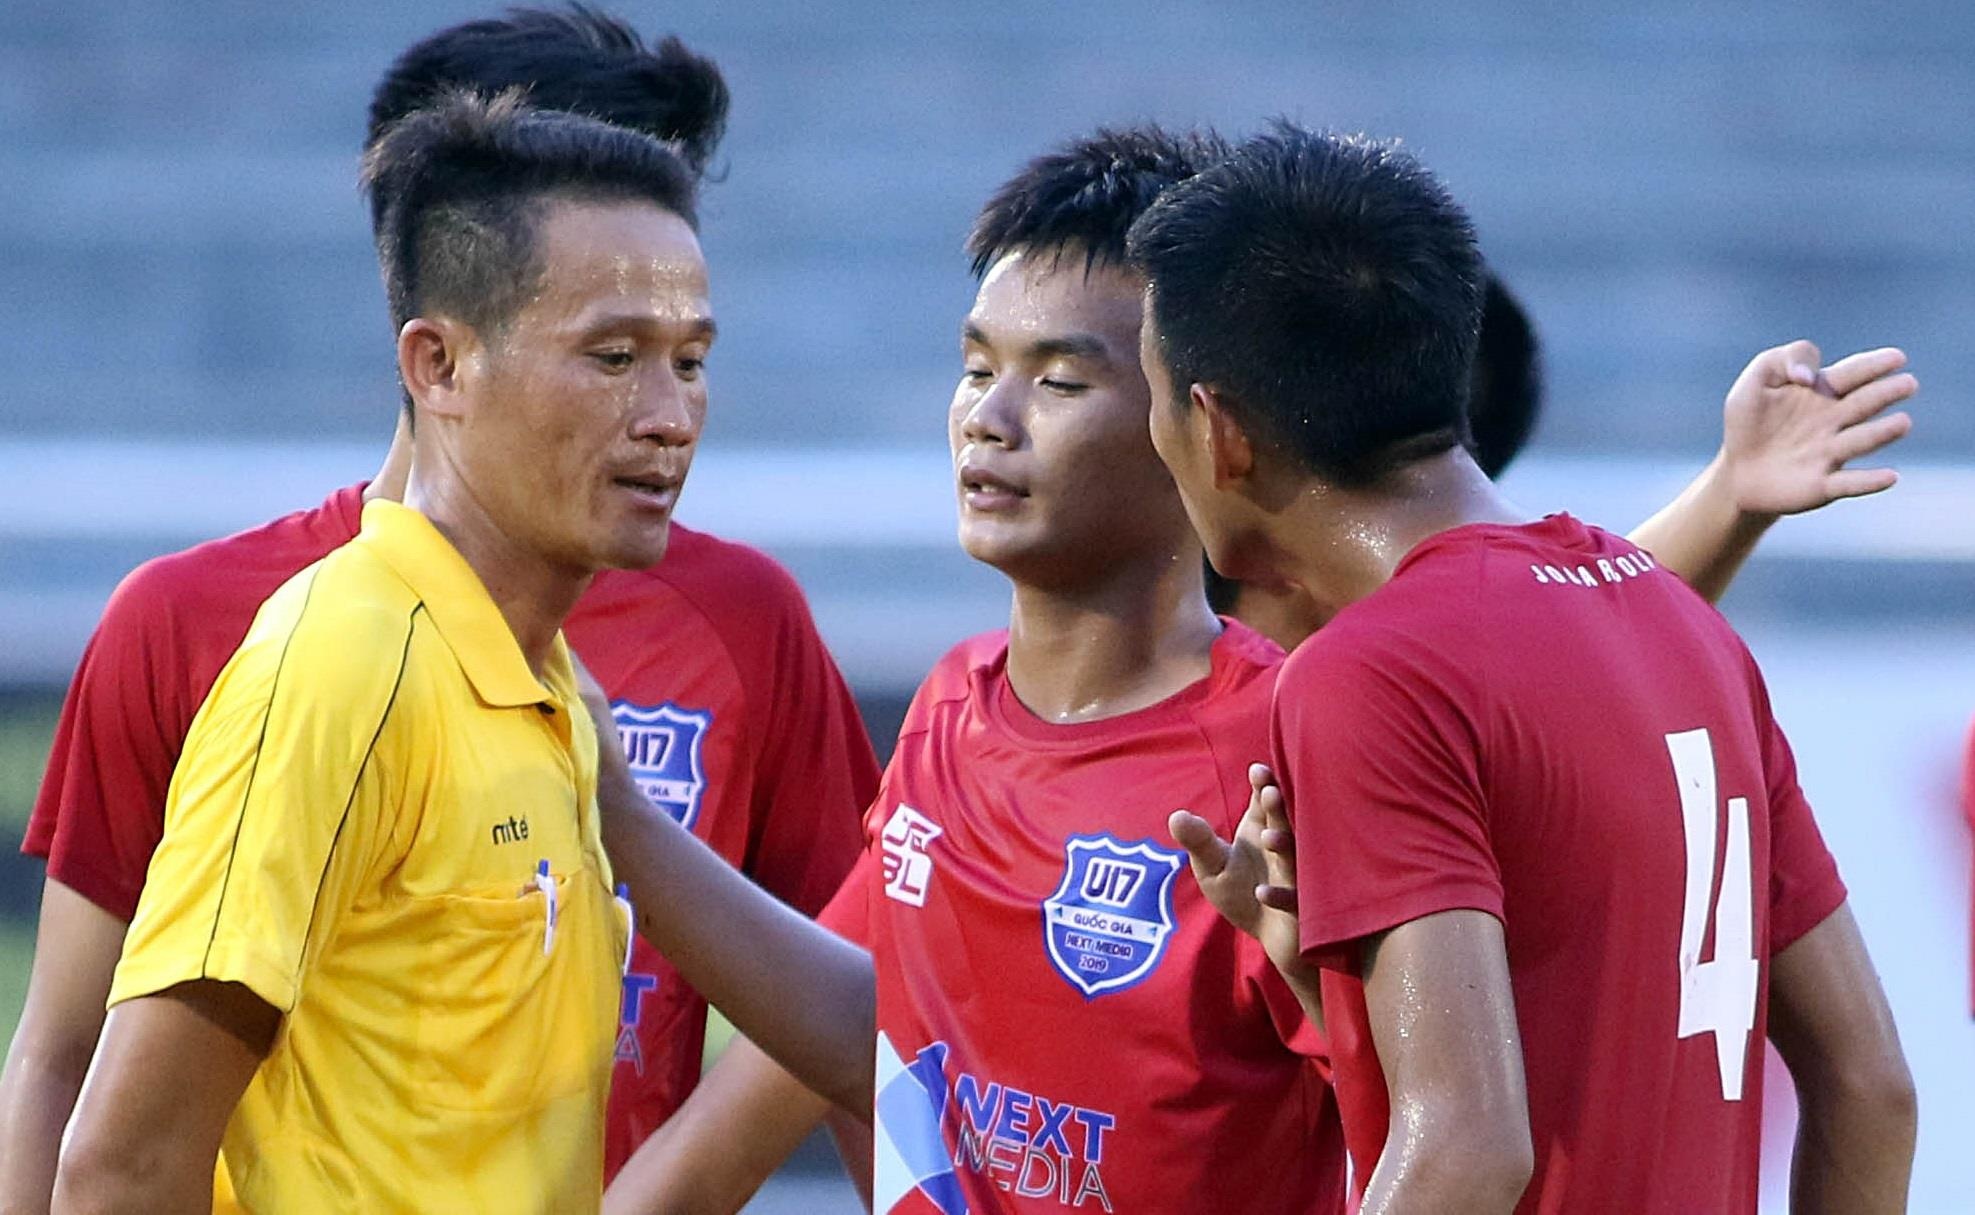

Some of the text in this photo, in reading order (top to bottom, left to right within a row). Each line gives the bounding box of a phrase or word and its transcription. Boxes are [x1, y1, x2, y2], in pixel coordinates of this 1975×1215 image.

[1530, 564, 1599, 588] JOLA
[1083, 860, 1143, 905] U17
[1664, 727, 1760, 1102] 4
[1110, 920, 1134, 936] GIA
[1065, 932, 1134, 958] NEXT MEDIA
[1080, 954, 1108, 972] 2019
[954, 1072, 1116, 1166] NEXT
